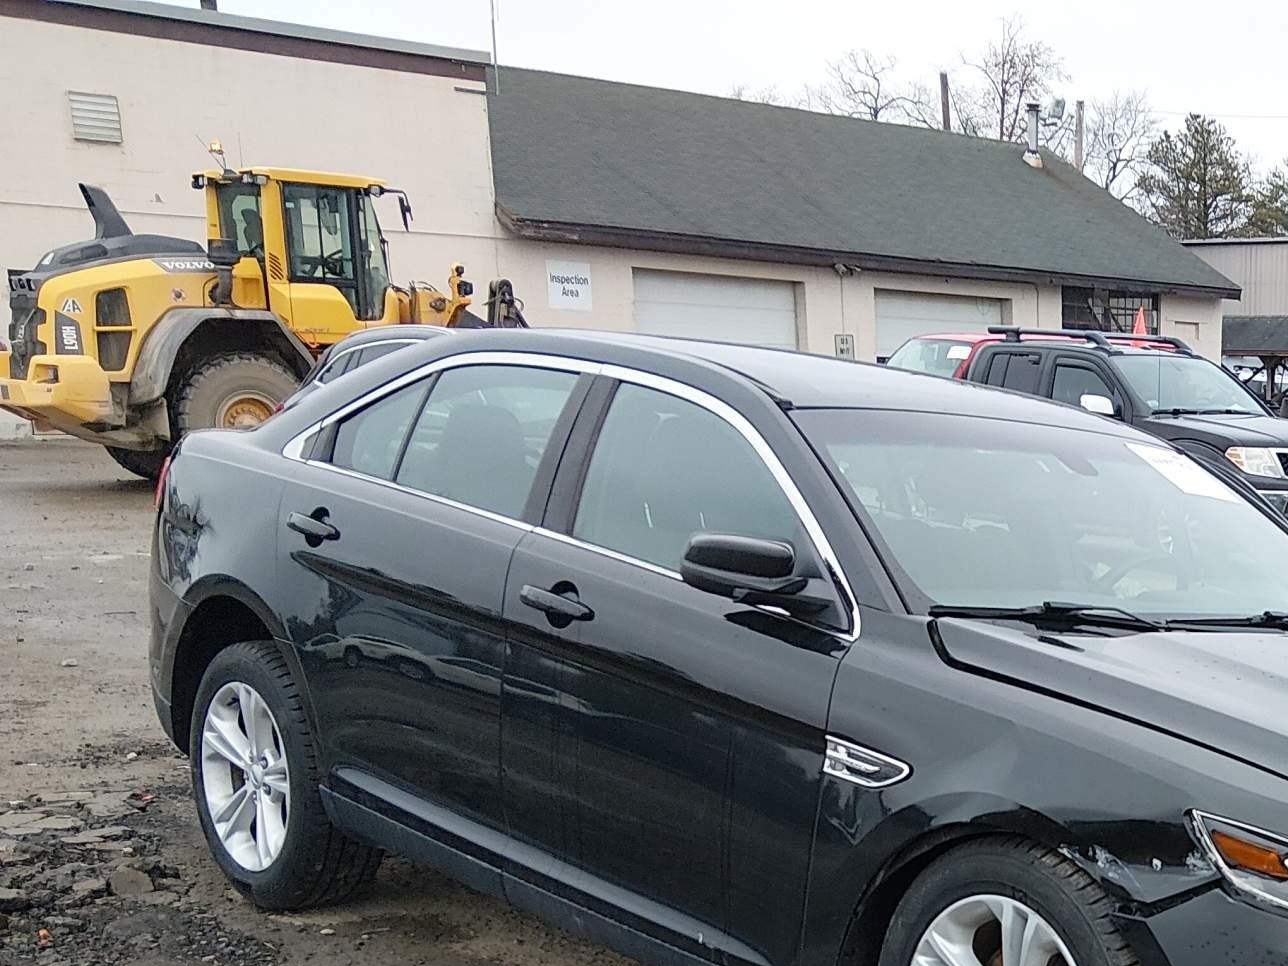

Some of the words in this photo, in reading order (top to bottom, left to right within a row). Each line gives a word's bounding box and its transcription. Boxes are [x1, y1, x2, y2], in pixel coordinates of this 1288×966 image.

[162, 261, 215, 270] VOLVO
[549, 272, 589, 286] Inspection
[561, 286, 580, 298] Area
[61, 325, 79, 350] L90H
